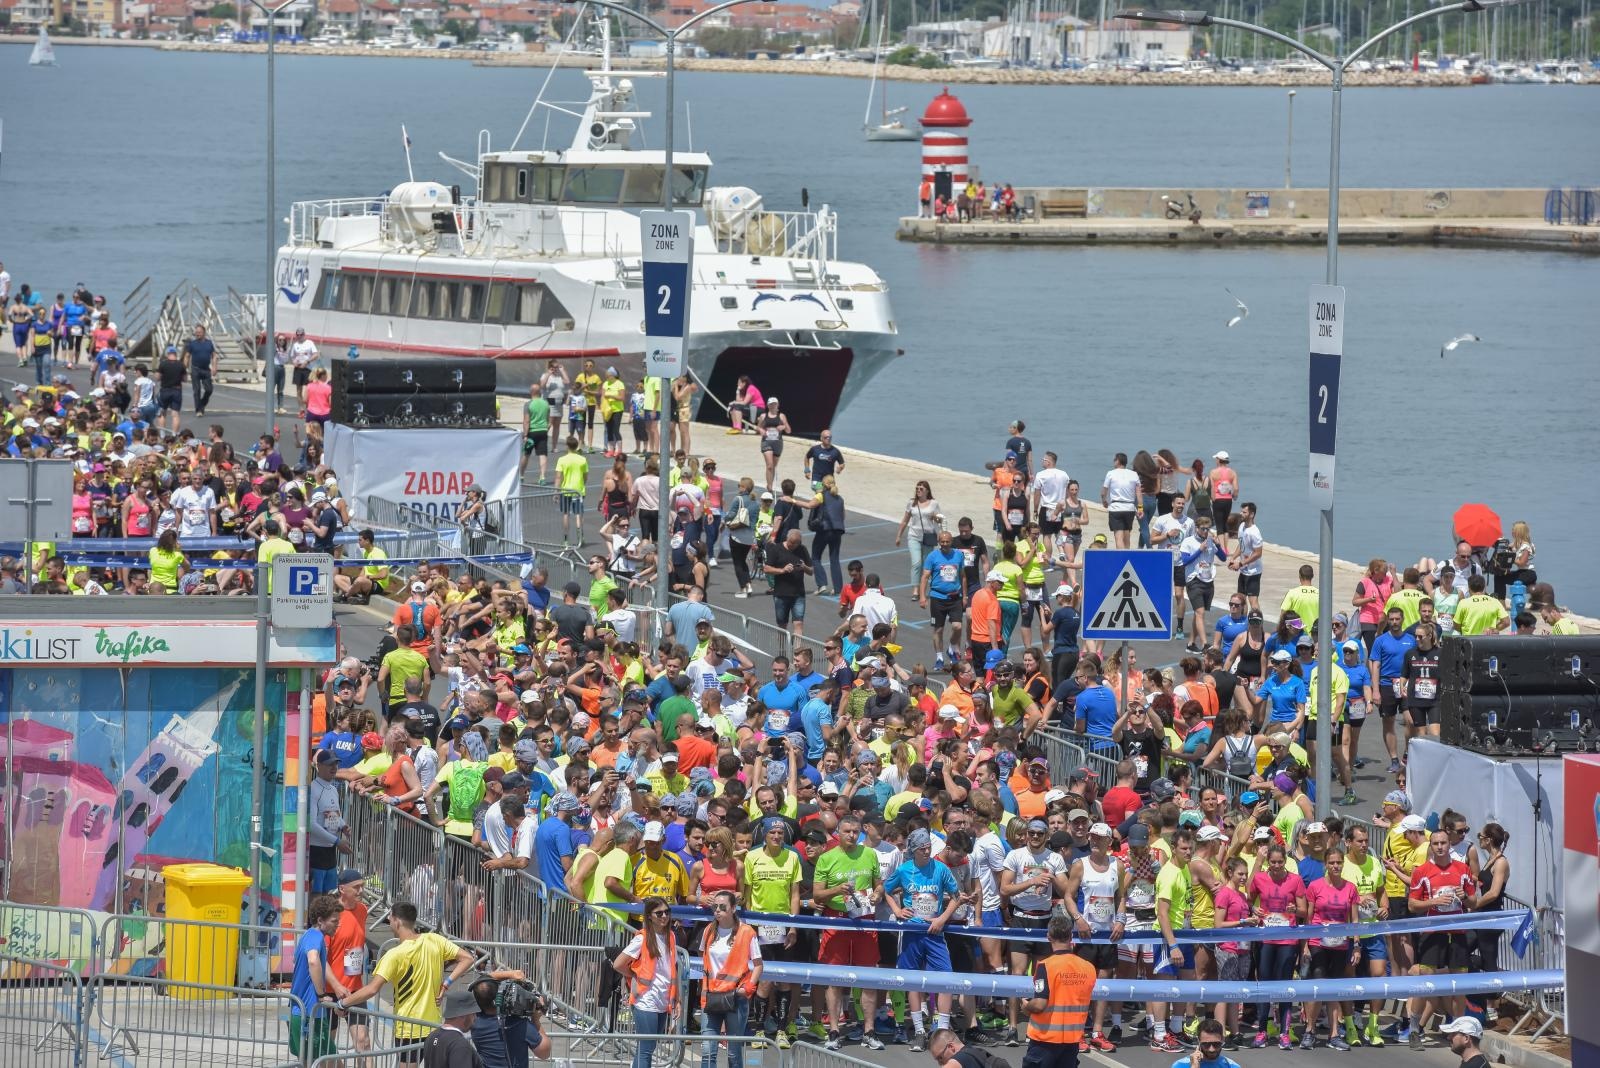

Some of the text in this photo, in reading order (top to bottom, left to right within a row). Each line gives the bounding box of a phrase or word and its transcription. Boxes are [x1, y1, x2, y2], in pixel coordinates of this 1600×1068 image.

[651, 224, 680, 238] ZONA
[655, 240, 675, 250] ZONE
[600, 298, 632, 310] MELITA
[657, 284, 671, 315] 2
[1316, 302, 1337, 321] ZONA
[1318, 324, 1333, 337] ZONE
[1318, 384, 1329, 423] 2
[404, 471, 475, 495] ZADAR
[296, 570, 314, 592] P
[95, 628, 171, 662] trafika
